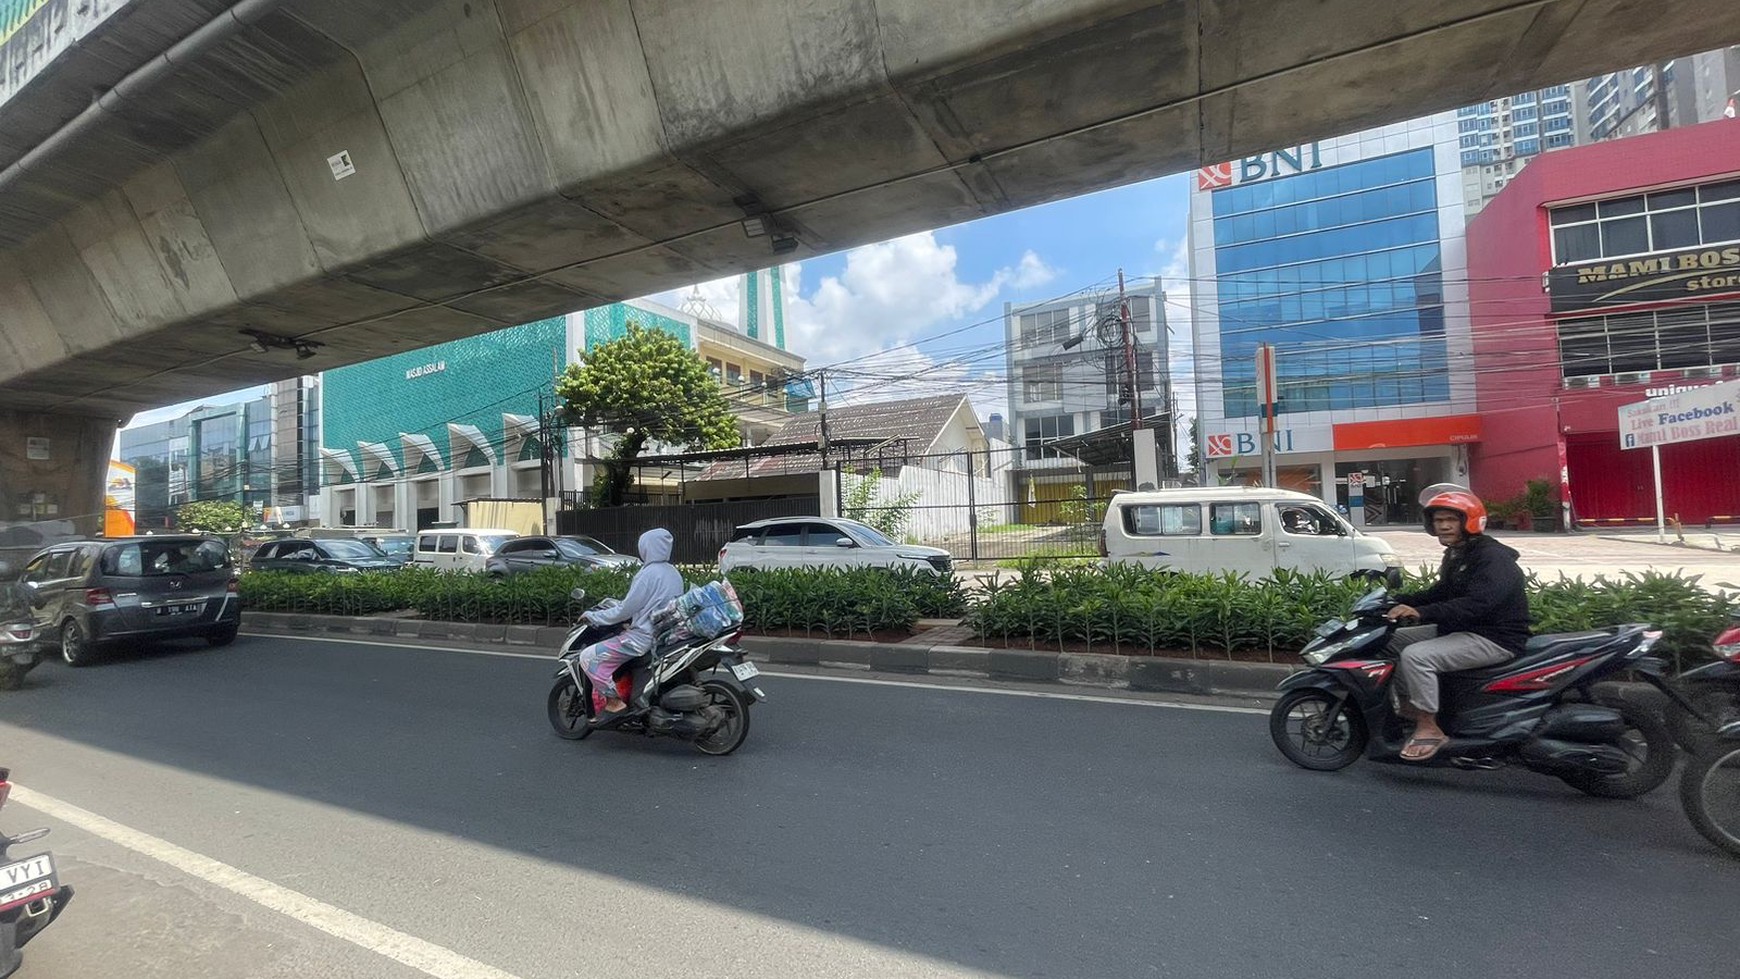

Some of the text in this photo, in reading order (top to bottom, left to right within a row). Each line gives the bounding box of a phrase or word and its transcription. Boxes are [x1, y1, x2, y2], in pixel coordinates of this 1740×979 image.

[1240, 141, 1322, 183] BNI
[1578, 256, 1671, 284] MAMI
[1686, 275, 1740, 291] stor
[1632, 401, 1734, 430] Live Facebook
[1670, 424, 1701, 440] Boss
[1705, 416, 1738, 435] Real
[6, 861, 44, 883] VYI
